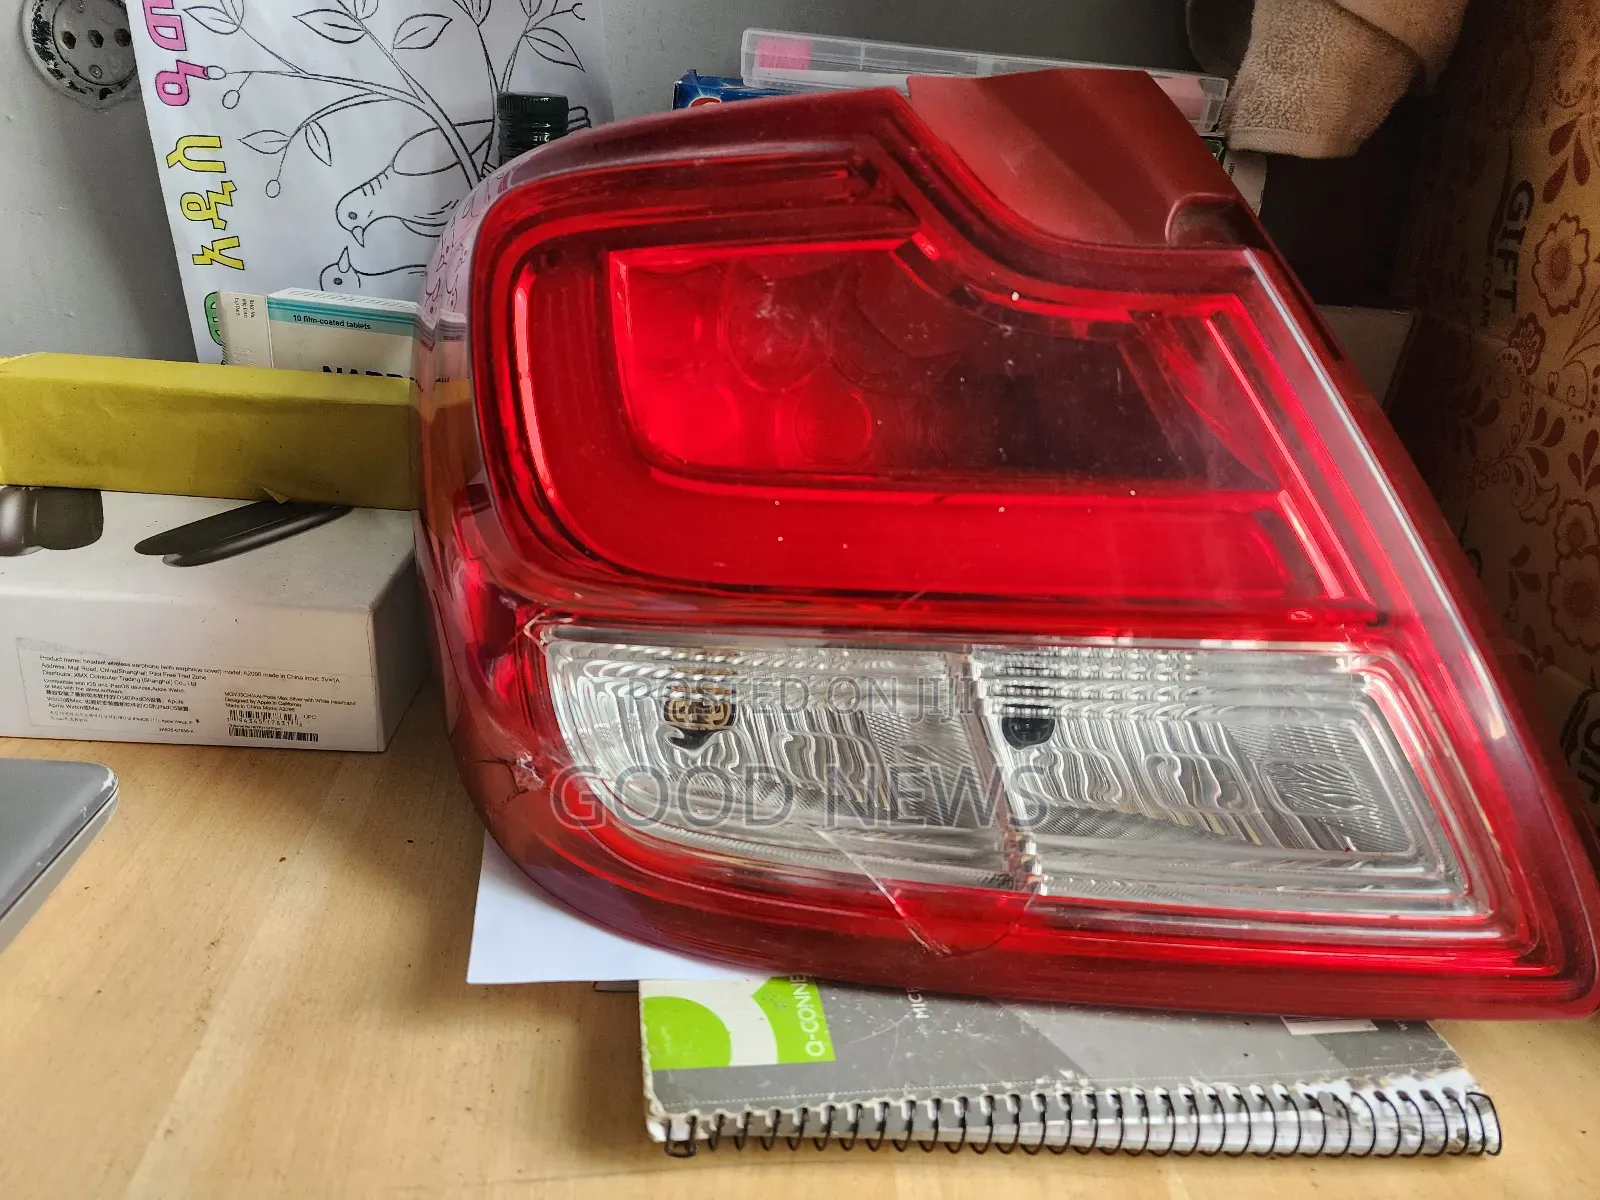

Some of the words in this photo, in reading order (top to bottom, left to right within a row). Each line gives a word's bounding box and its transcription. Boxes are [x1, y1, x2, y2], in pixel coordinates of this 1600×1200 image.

[1494, 180, 1535, 313] GIFT
[292, 314, 302, 322] 10
[303, 314, 345, 327] film-coated
